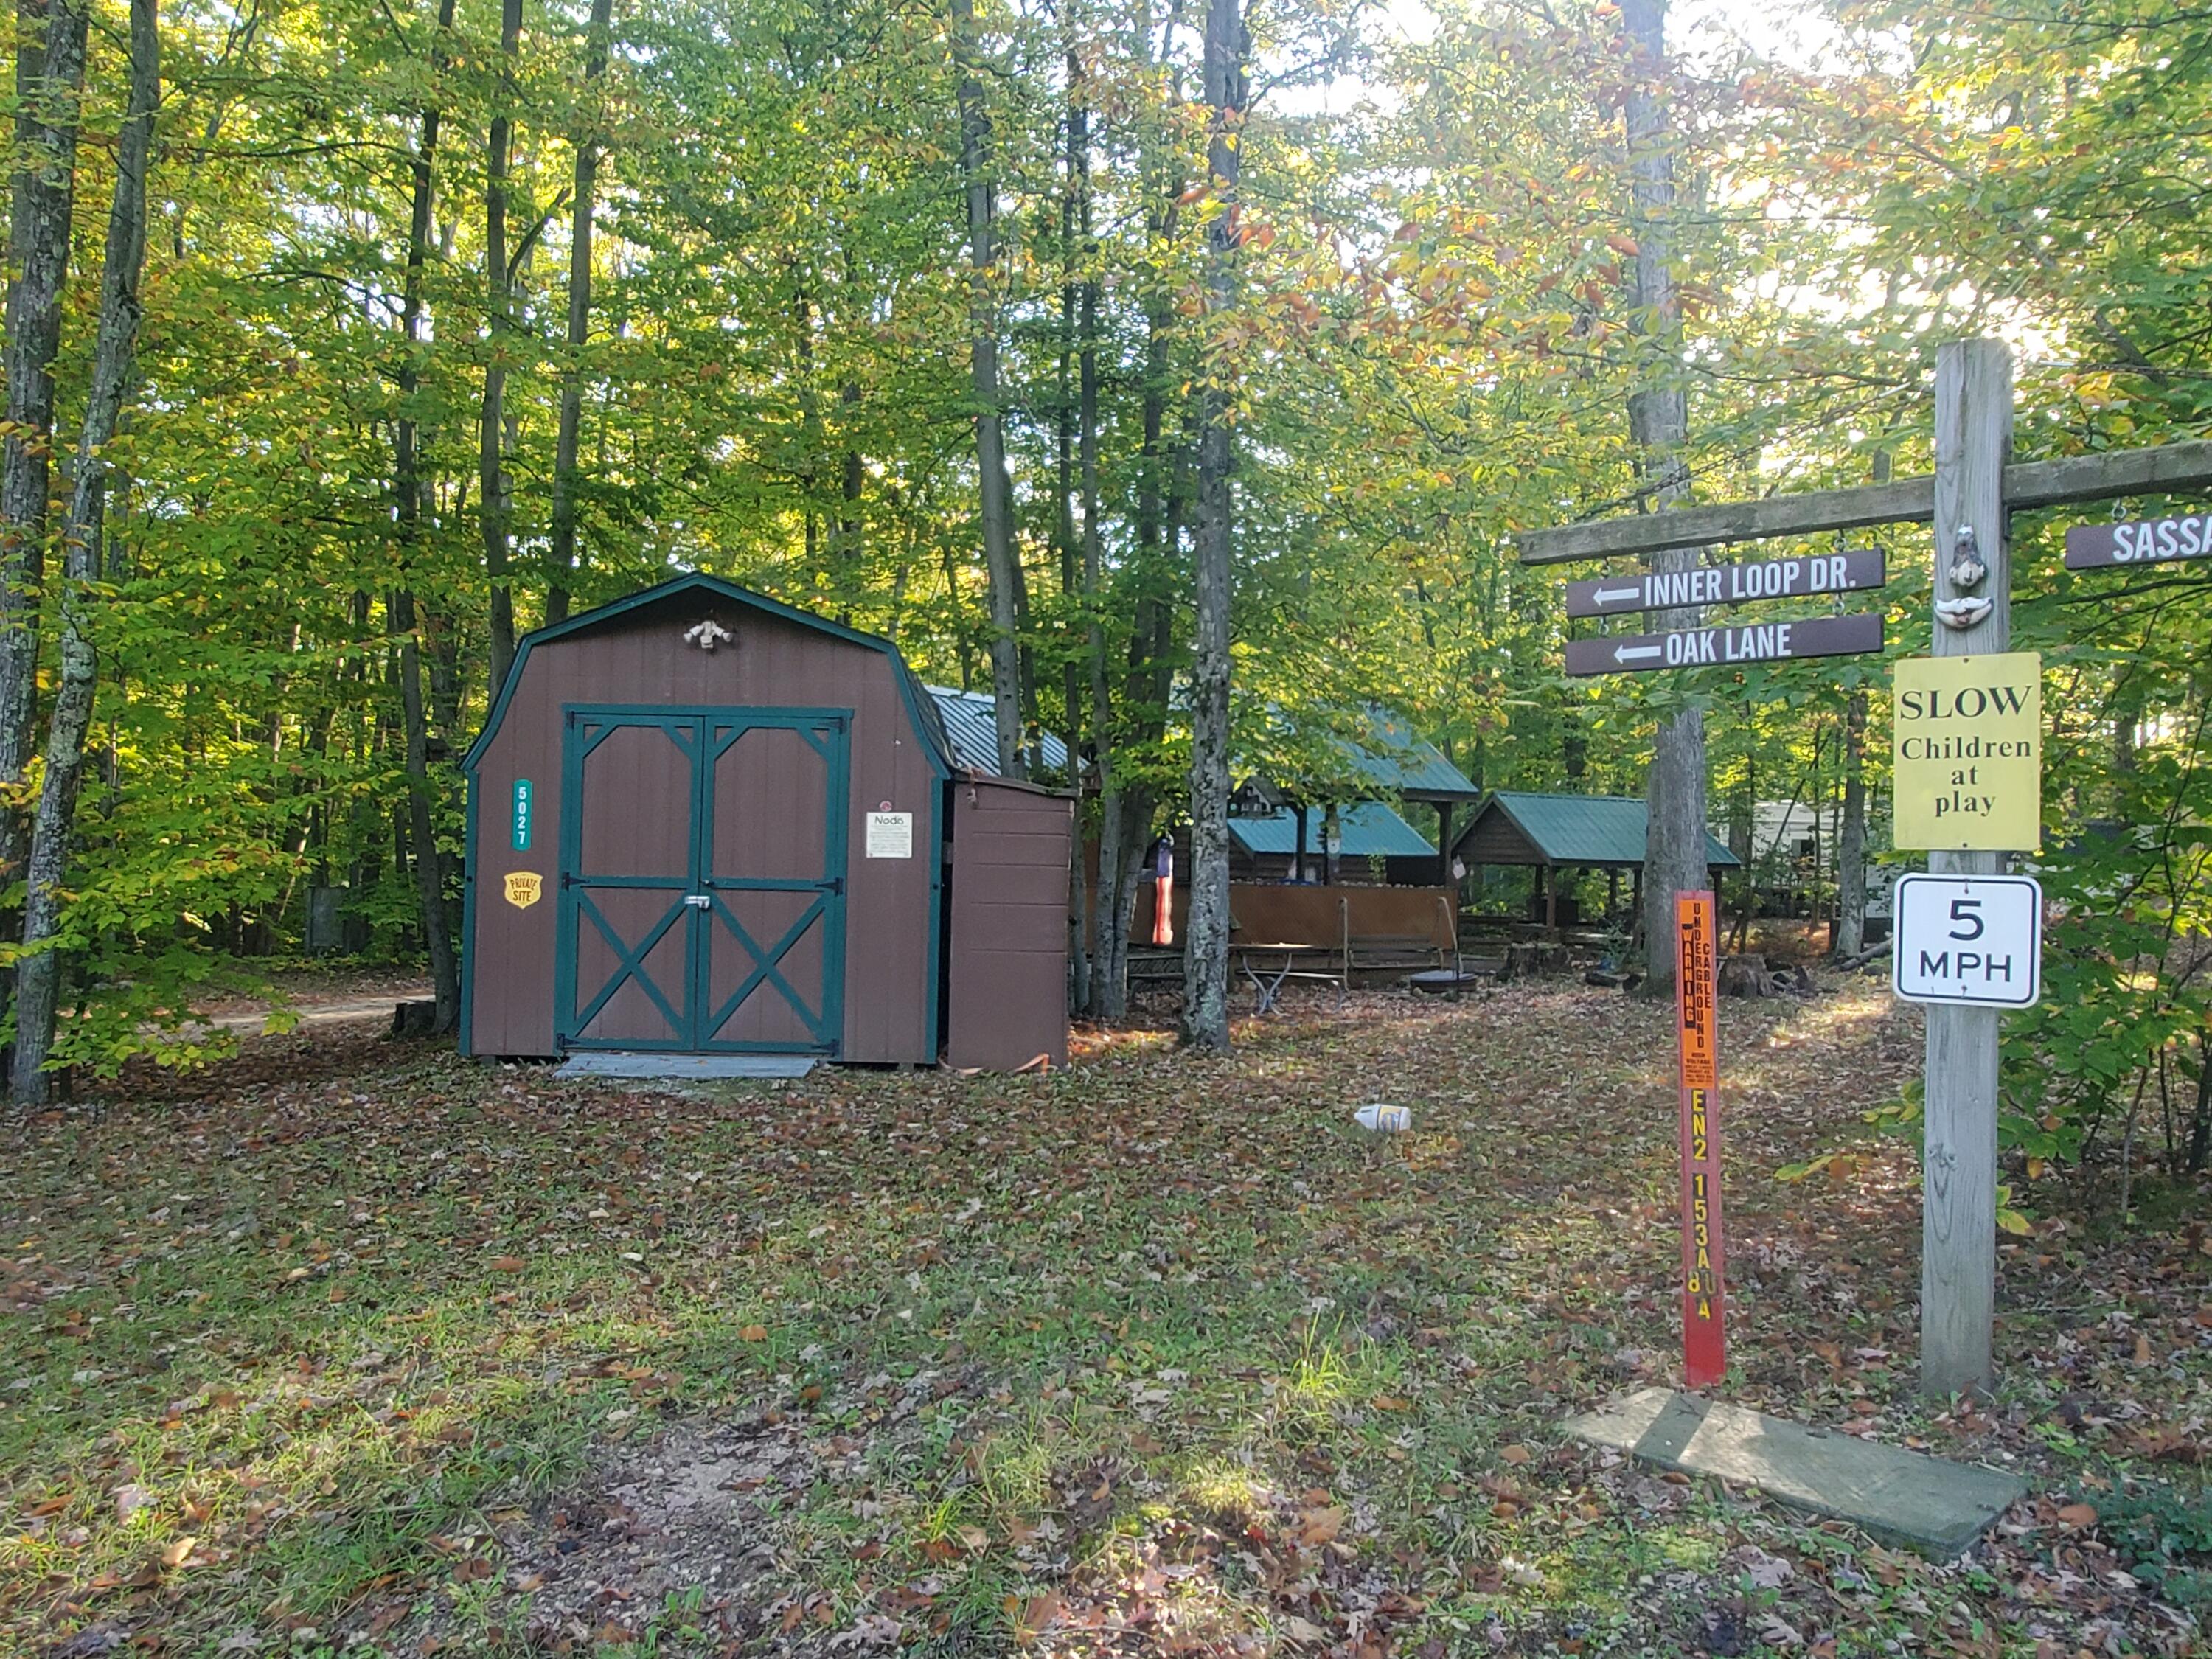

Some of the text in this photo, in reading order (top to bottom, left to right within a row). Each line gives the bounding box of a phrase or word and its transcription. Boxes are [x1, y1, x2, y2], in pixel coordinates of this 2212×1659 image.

[1644, 556, 1856, 607] INNER LOOP DR.
[1666, 624, 1792, 664] OAK LANE
[1900, 685, 2033, 720] SLOW
[1901, 736, 2031, 760] Children
[1951, 765, 1978, 785] at
[518, 787, 527, 844] 5027
[1935, 790, 1996, 817] play
[510, 878, 538, 891] PRIVATE
[512, 890, 532, 902] SITE
[1948, 900, 1984, 941] 5
[1682, 928, 1694, 1021] WARNING
[1693, 902, 1704, 1048] UNDERGROUND
[1703, 943, 1711, 1009] CABLE
[1920, 950, 2011, 982] MPH
